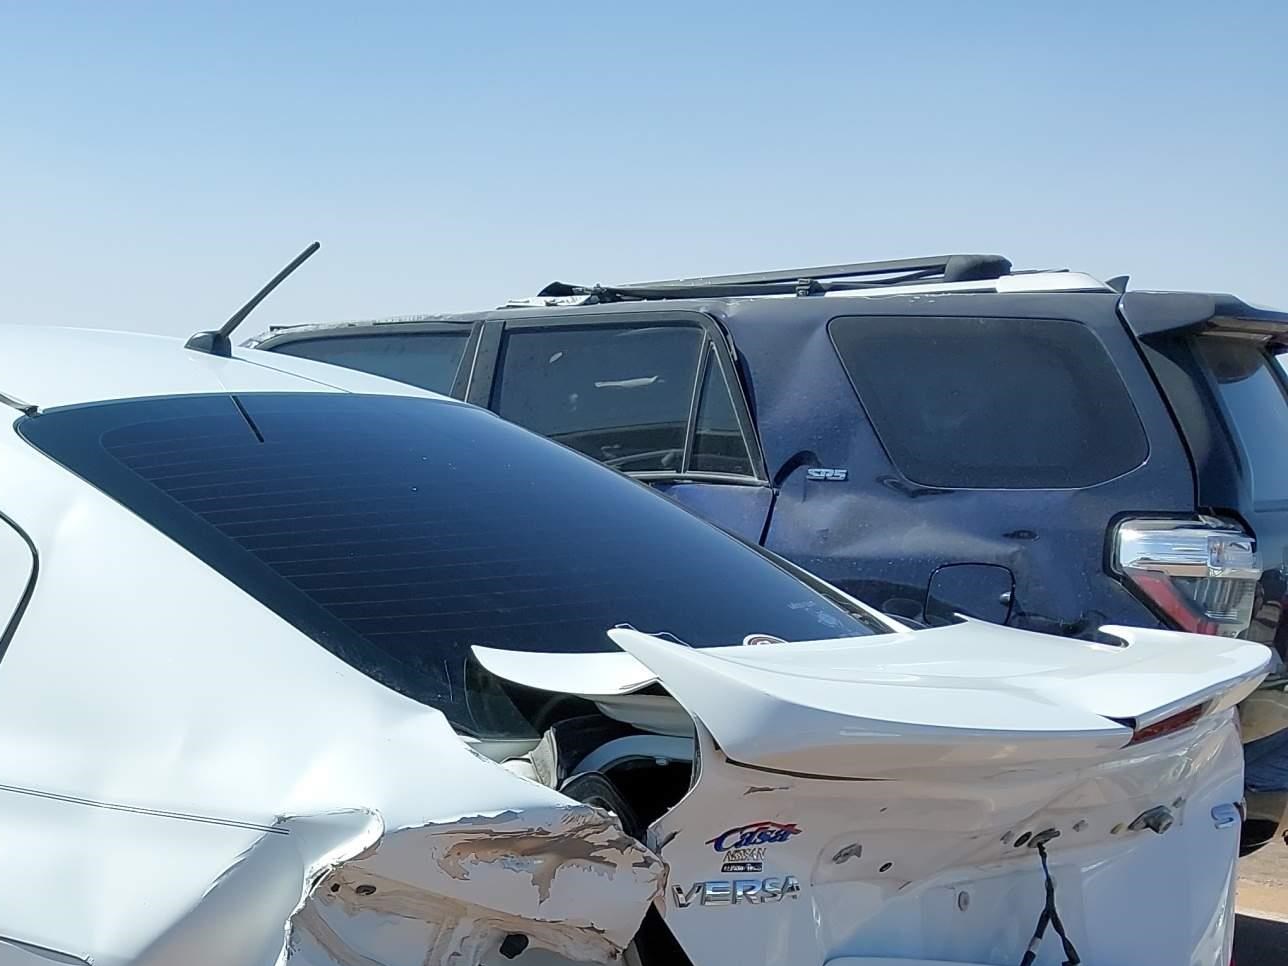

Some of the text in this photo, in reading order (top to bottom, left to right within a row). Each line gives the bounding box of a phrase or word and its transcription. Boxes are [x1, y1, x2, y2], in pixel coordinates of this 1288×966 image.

[806, 468, 848, 481] SR5
[712, 825, 795, 853] Casa
[671, 875, 801, 908] VERSA
